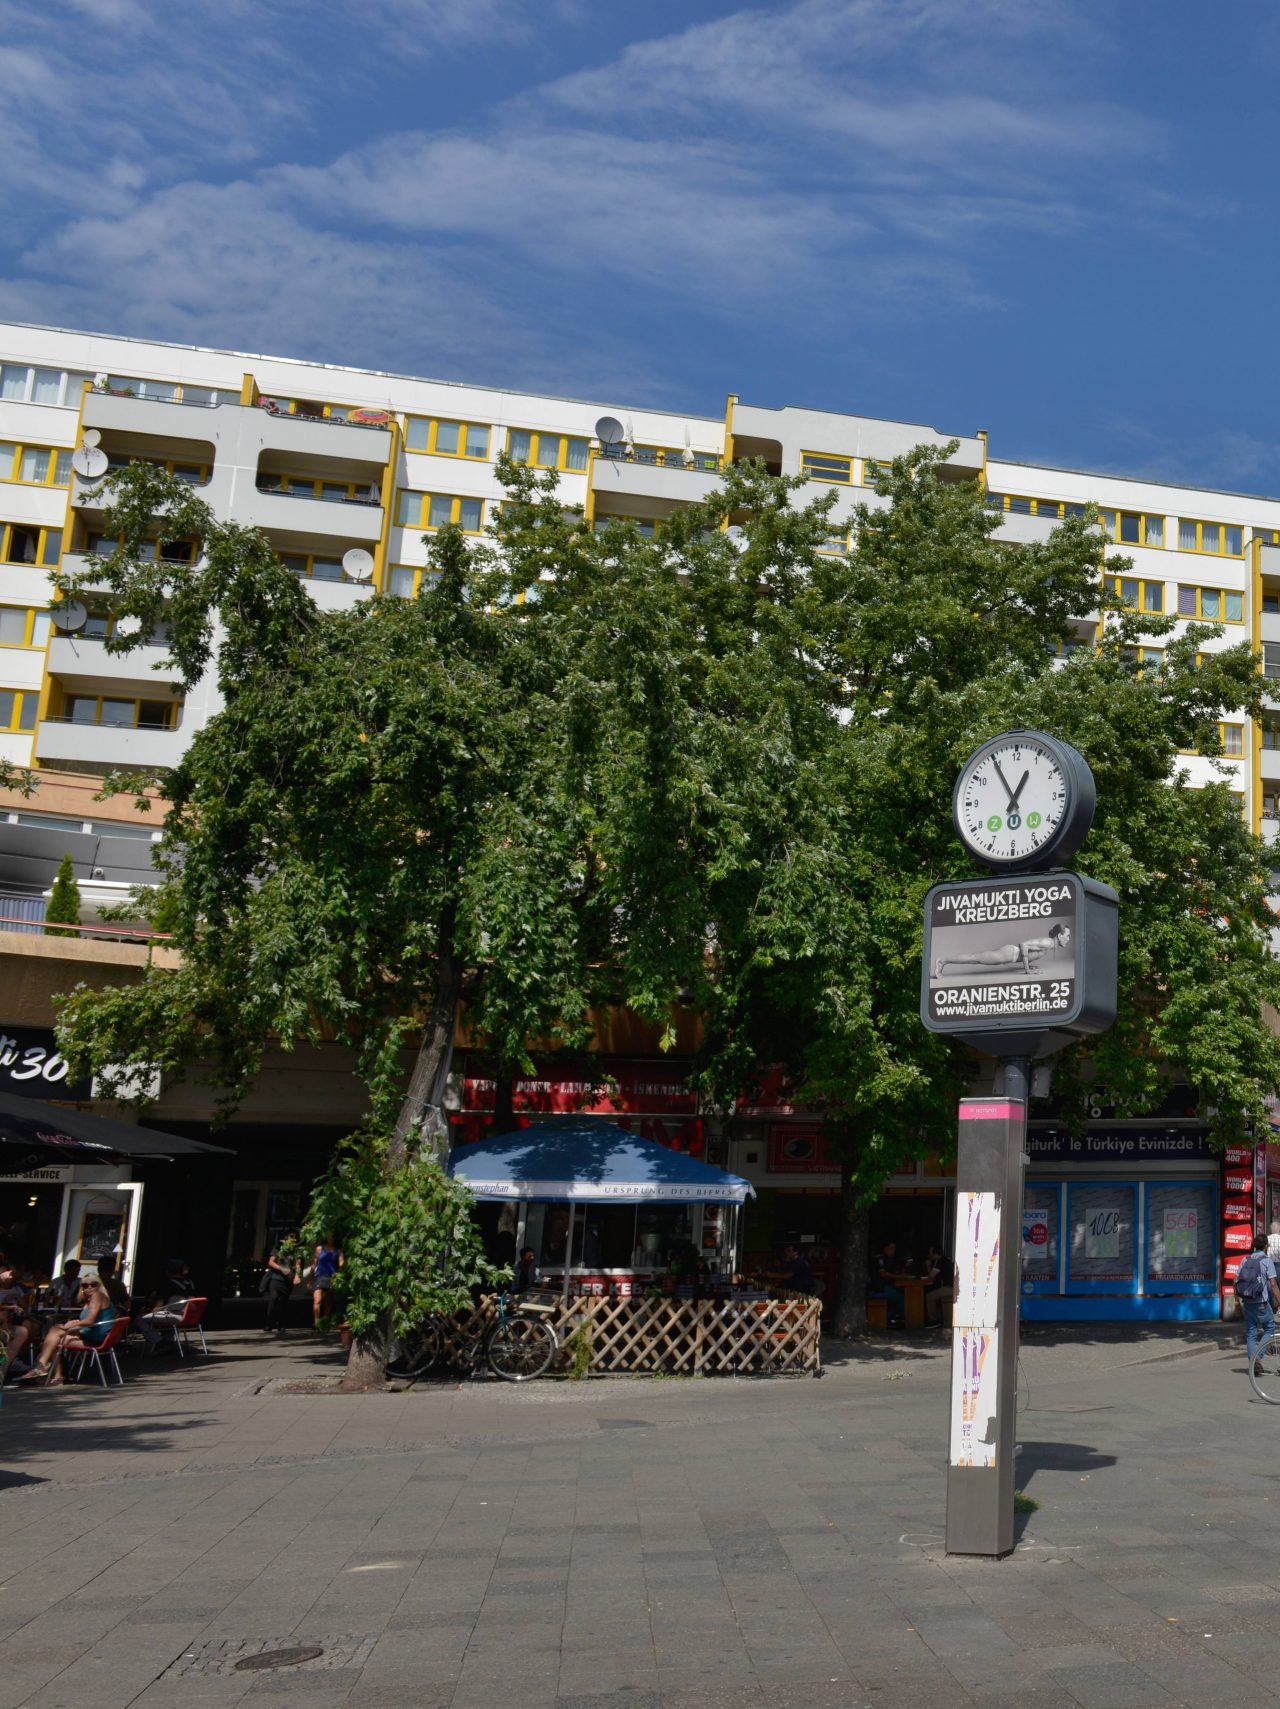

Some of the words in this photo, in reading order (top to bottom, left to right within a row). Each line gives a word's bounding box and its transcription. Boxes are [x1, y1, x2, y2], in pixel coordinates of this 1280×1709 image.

[1012, 752, 1021, 761] 12
[1048, 771, 1053, 780] 2
[979, 778, 987, 786] 10
[1052, 792, 1057, 801] 3
[974, 800, 979, 808] 9
[1046, 814, 1051, 822] 4
[978, 821, 983, 829] 8
[992, 835, 997, 844] 7
[1031, 832, 1036, 841] 5
[1011, 840, 1016, 848] 6
[937, 890, 1020, 911] JIVAMUKTI
[1025, 885, 1072, 901] YOGA
[955, 902, 1052, 924] KREUZBERG
[934, 984, 1047, 1005] ORANIENSTR.
[1050, 982, 1070, 997] 25
[936, 997, 1068, 1016] www.jivamuktiberlin.de
[1070, 1136, 1081, 1150] le
[1085, 1136, 1135, 1154] Türkiye
[1138, 1135, 1194, 1150] Evinizde
[1225, 1155, 1240, 1163] 400
[604, 1186, 665, 1195] URSPRUNG
[671, 1187, 690, 1195] DES
